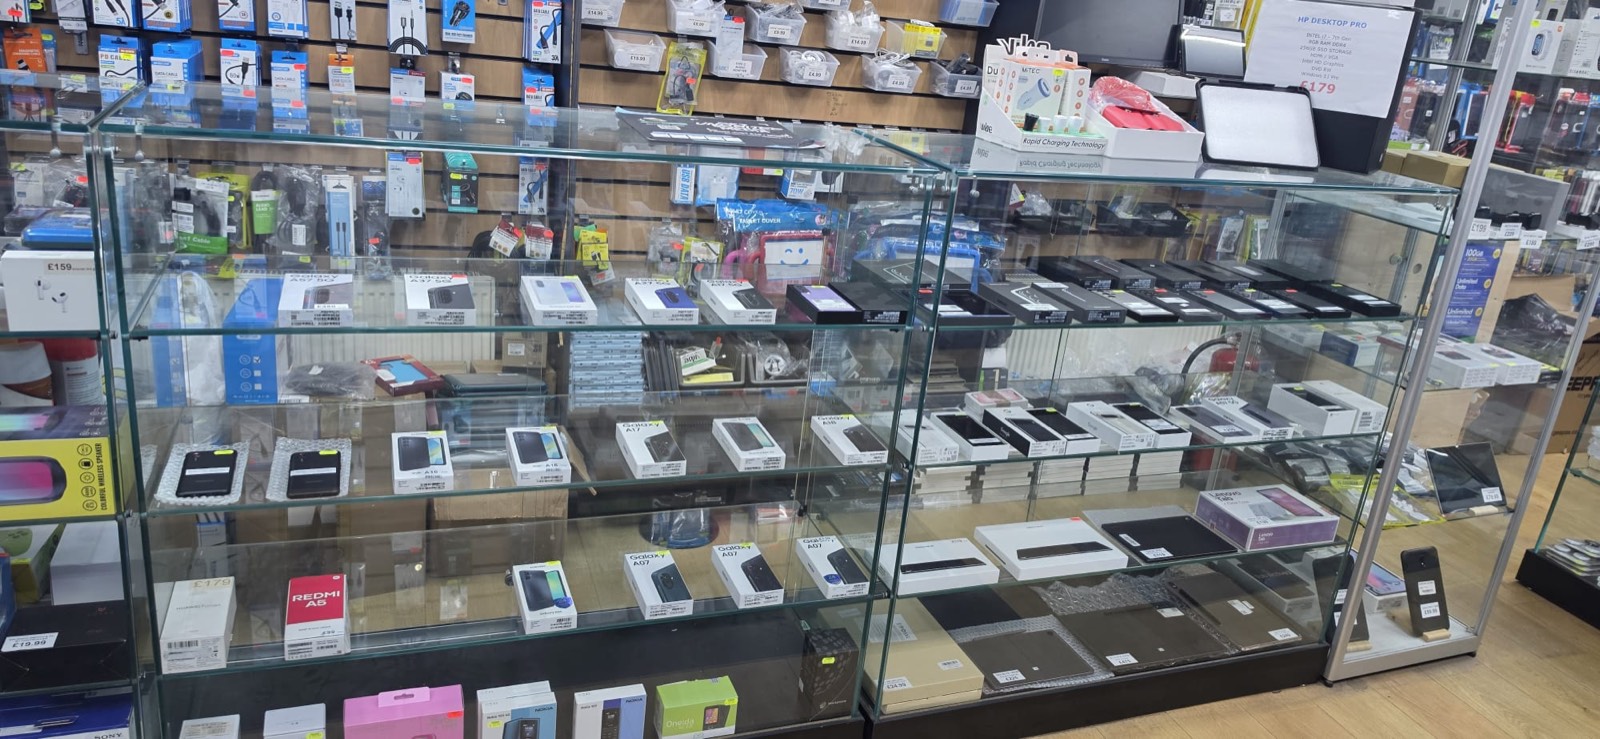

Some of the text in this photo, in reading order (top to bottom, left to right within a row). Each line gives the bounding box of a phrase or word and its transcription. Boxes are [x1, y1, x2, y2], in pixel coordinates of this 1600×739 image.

[1311, 17, 1347, 26] DESKTOP
[1300, 80, 1336, 94] £179
[1023, 138, 1106, 153] Rapid Charging Technology
[680, 168, 690, 201] USB DATA
[47, 263, 72, 271] £159
[622, 422, 661, 430] Galaxy
[95, 443, 103, 464] SPEAKER
[96, 464, 105, 487] WIRELESS
[98, 487, 108, 511] COLORFUL
[630, 552, 666, 560] Galaxy
[193, 579, 232, 588] £179
[292, 591, 341, 603] REDMI
[305, 599, 327, 608] A5
[12, 640, 47, 648] £19.99
